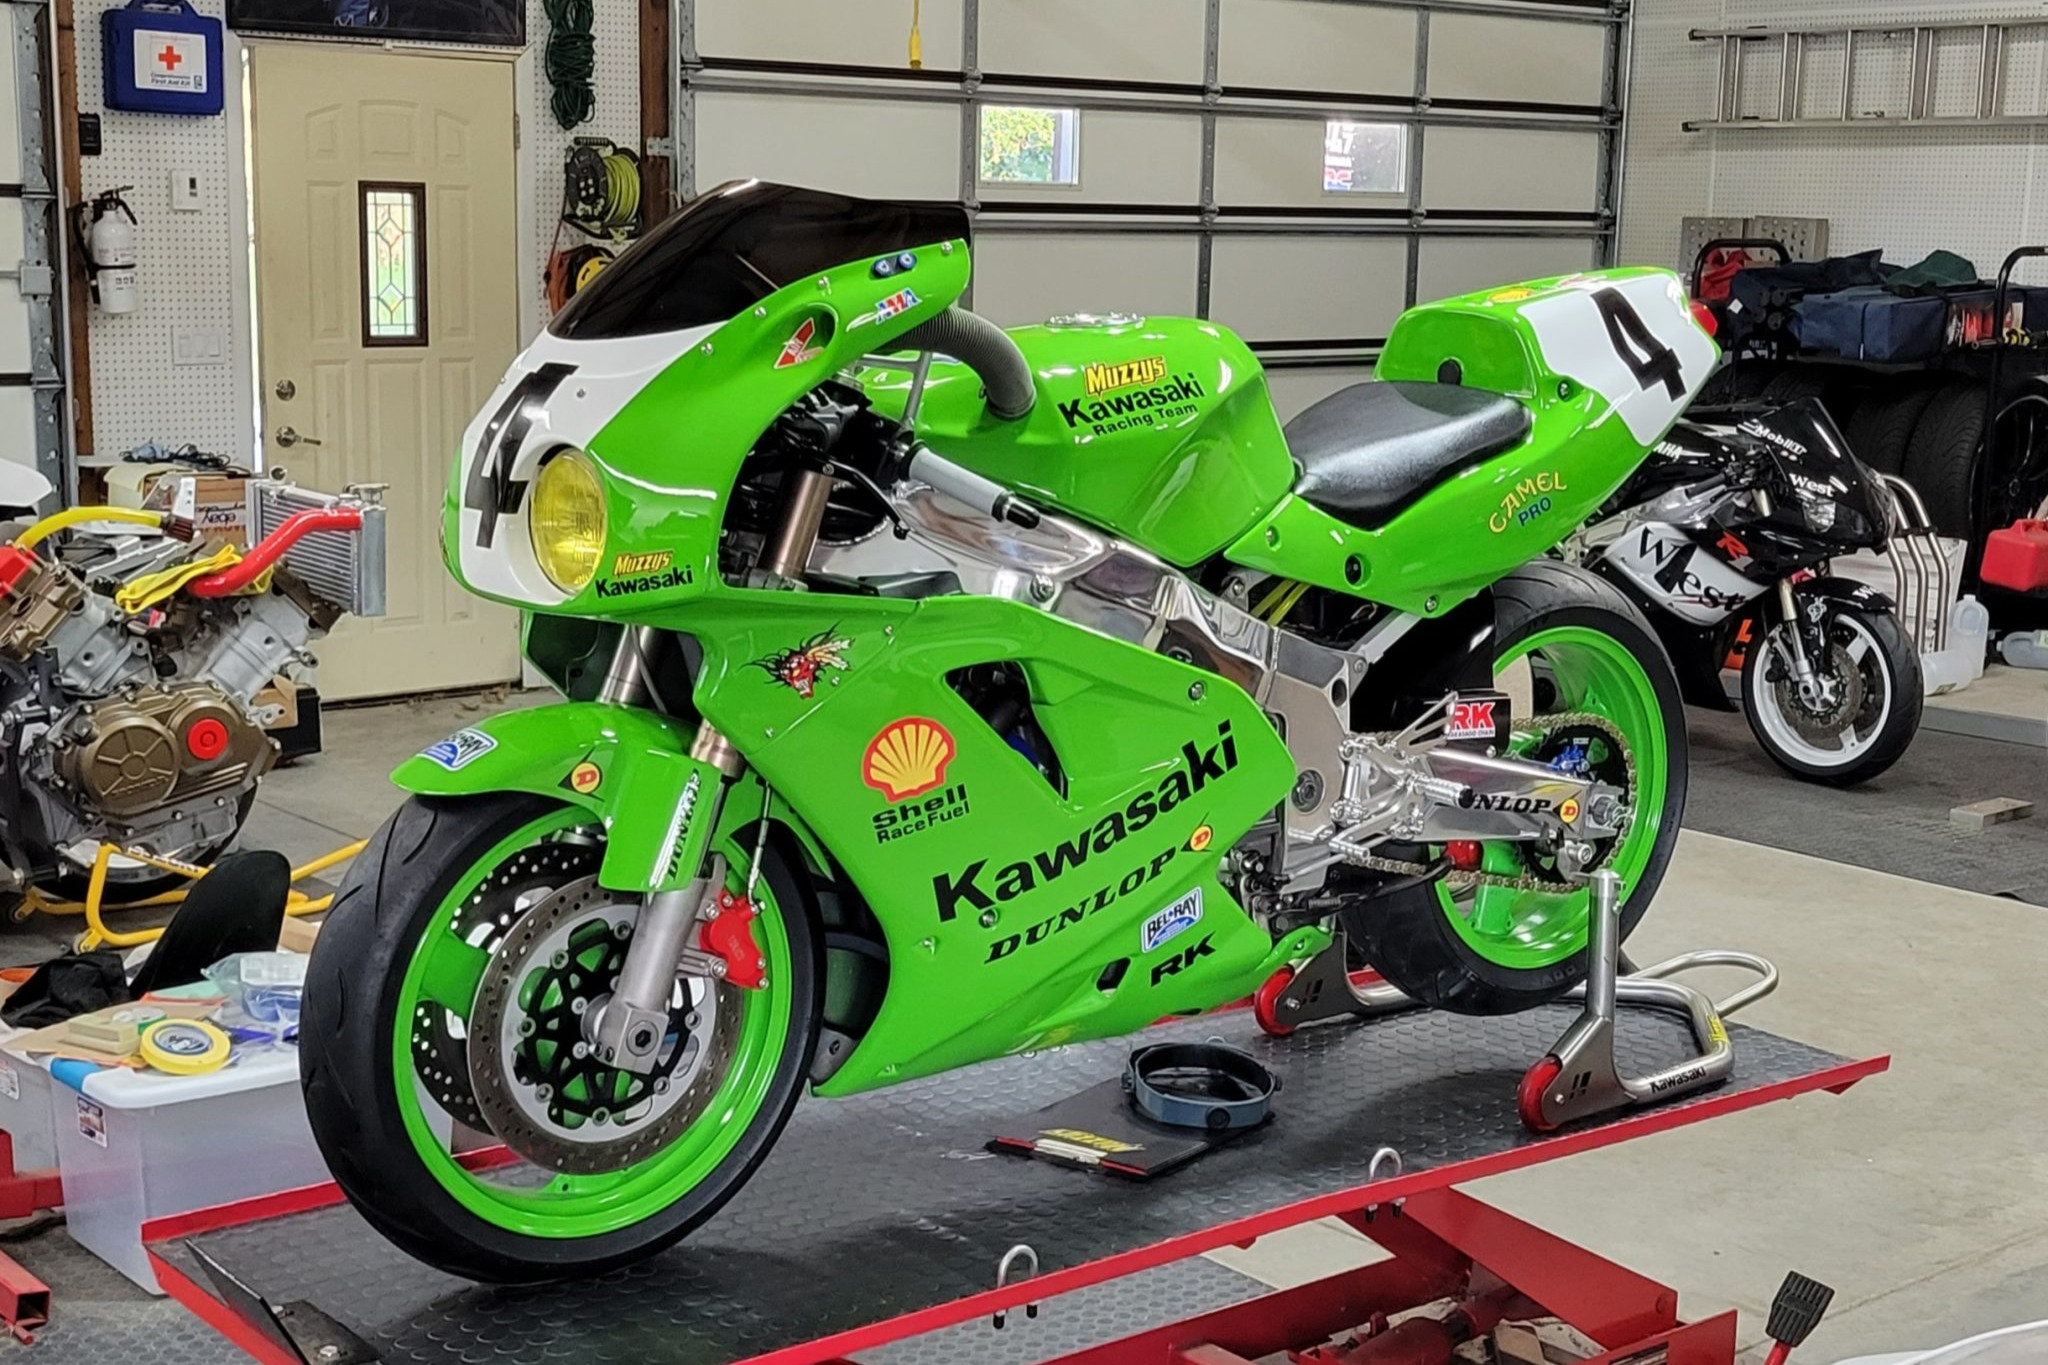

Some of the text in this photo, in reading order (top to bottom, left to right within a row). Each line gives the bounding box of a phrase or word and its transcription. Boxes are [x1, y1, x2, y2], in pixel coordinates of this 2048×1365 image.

[1590, 287, 1687, 401] 4
[1085, 357, 1165, 395] Muzzys
[1057, 372, 1205, 428] Kawasaki
[1092, 403, 1198, 436] Racing Team
[465, 362, 580, 549] 4
[1489, 471, 1568, 533] CAMEL
[1789, 473, 1836, 497] West
[1518, 496, 1552, 527] PRO
[595, 564, 694, 599] Kawasaki
[613, 550, 674, 577] Muzzys
[1451, 702, 1495, 730] RK
[872, 784, 967, 830] Shell
[932, 718, 1239, 923] Kawasaki
[1473, 793, 1552, 814] NLOP
[984, 846, 1177, 964] DUNLOP
[1150, 930, 1217, 988] RK
[1649, 1066, 1707, 1094] Kawasaki
